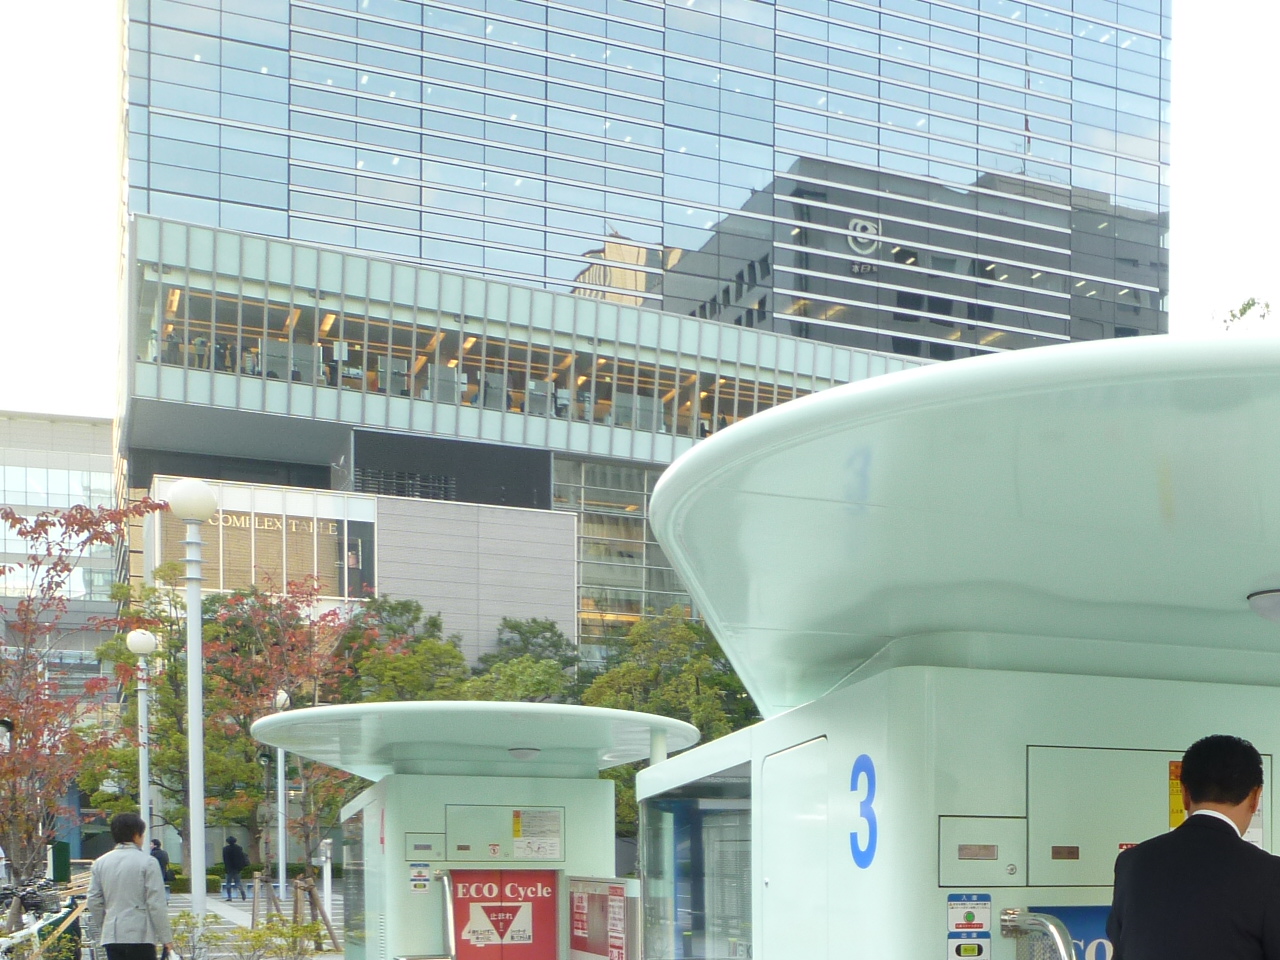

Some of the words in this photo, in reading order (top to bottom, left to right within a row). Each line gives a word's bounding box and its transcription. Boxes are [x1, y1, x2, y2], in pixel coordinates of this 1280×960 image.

[850, 754, 877, 869] 3
[457, 883, 499, 898] ECO
[505, 883, 552, 901] Cycle
